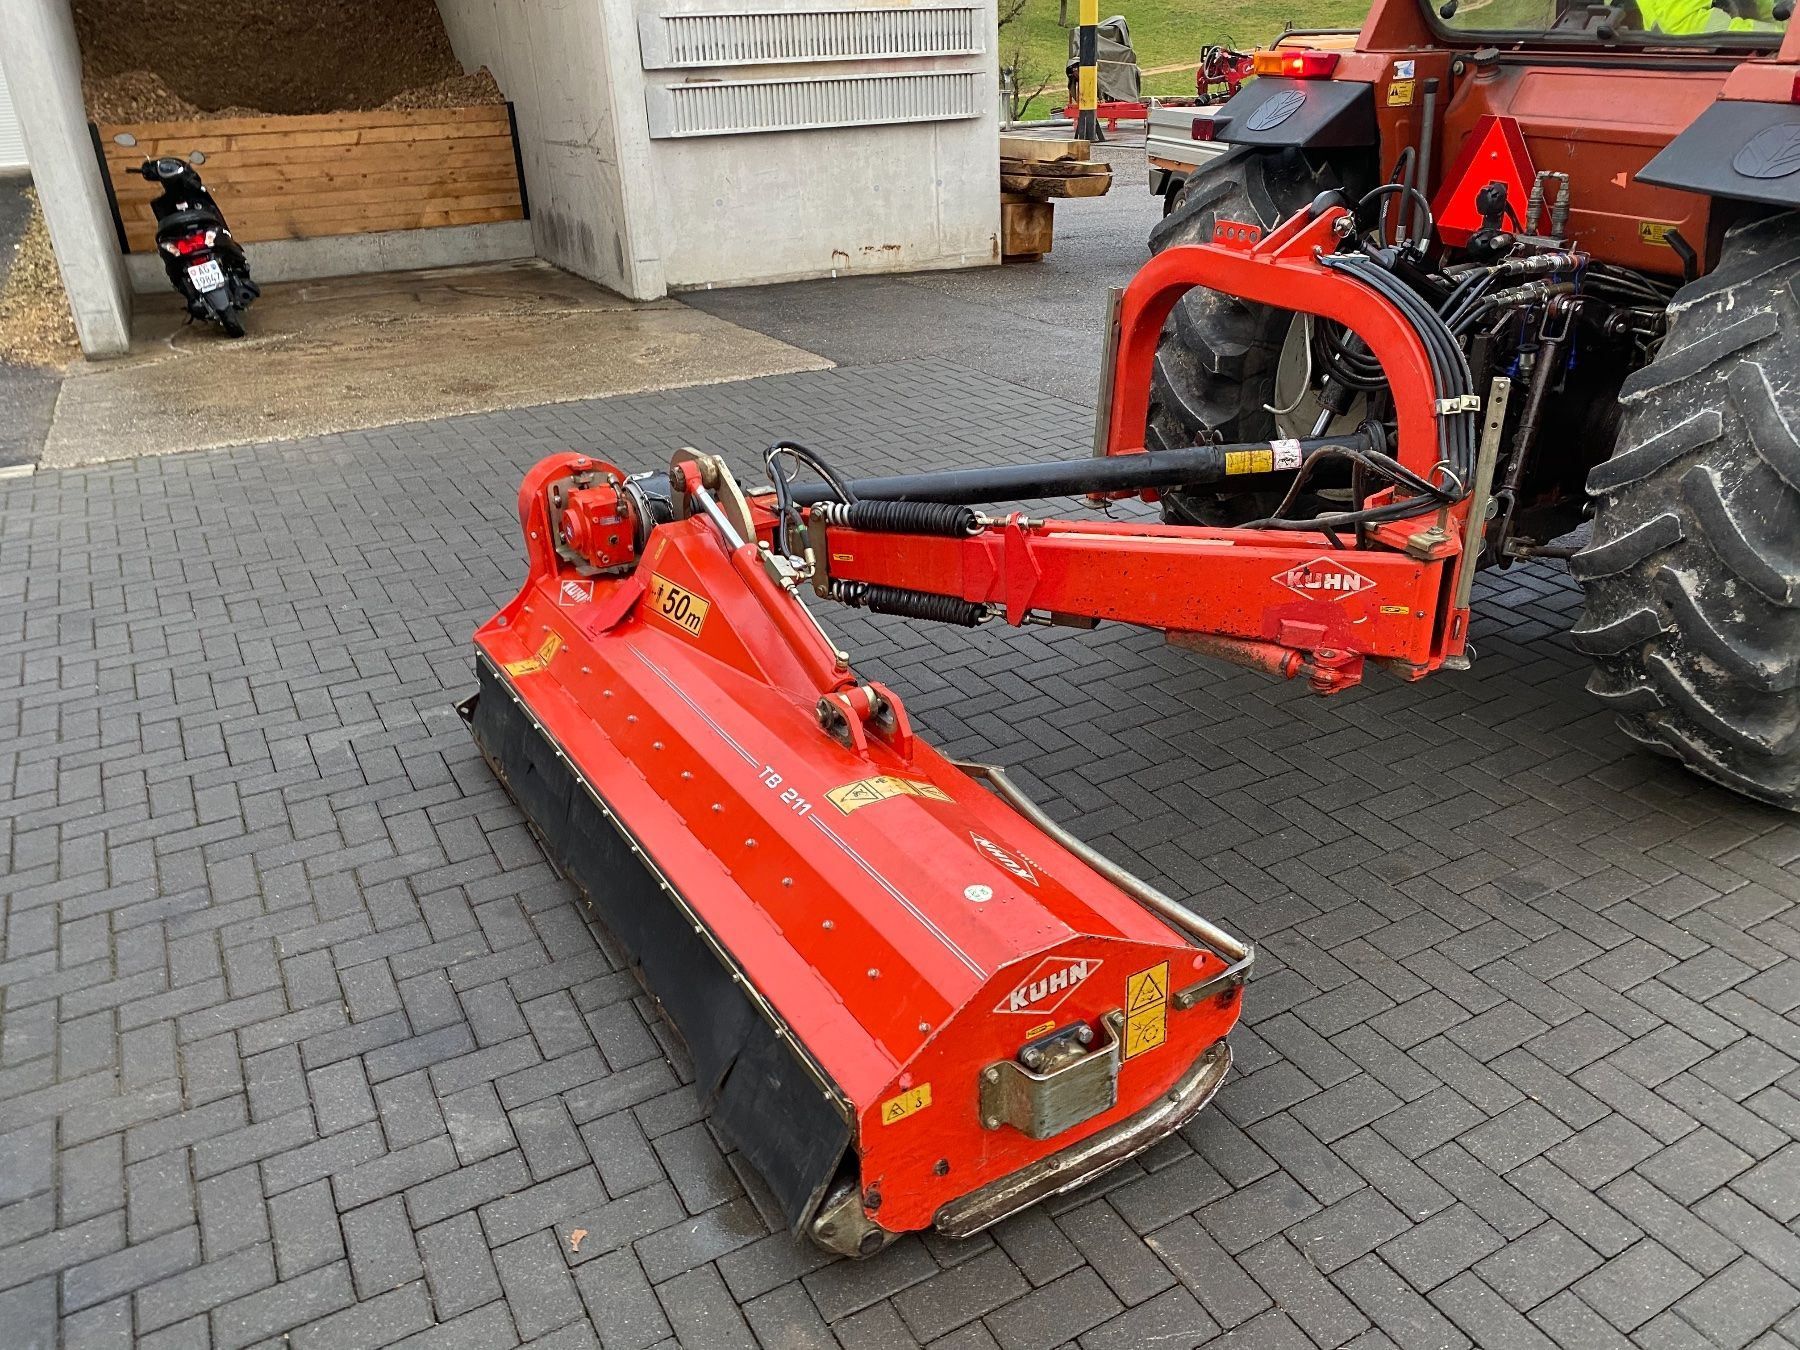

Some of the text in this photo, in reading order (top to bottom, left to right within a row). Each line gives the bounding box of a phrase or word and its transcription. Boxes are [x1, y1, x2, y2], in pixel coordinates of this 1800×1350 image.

[198, 264, 210, 275] AG
[1287, 571, 1361, 591] KUHN
[759, 765, 812, 816] TB 211
[973, 837, 1034, 879] KUHN
[1010, 960, 1088, 1012] KUHN
